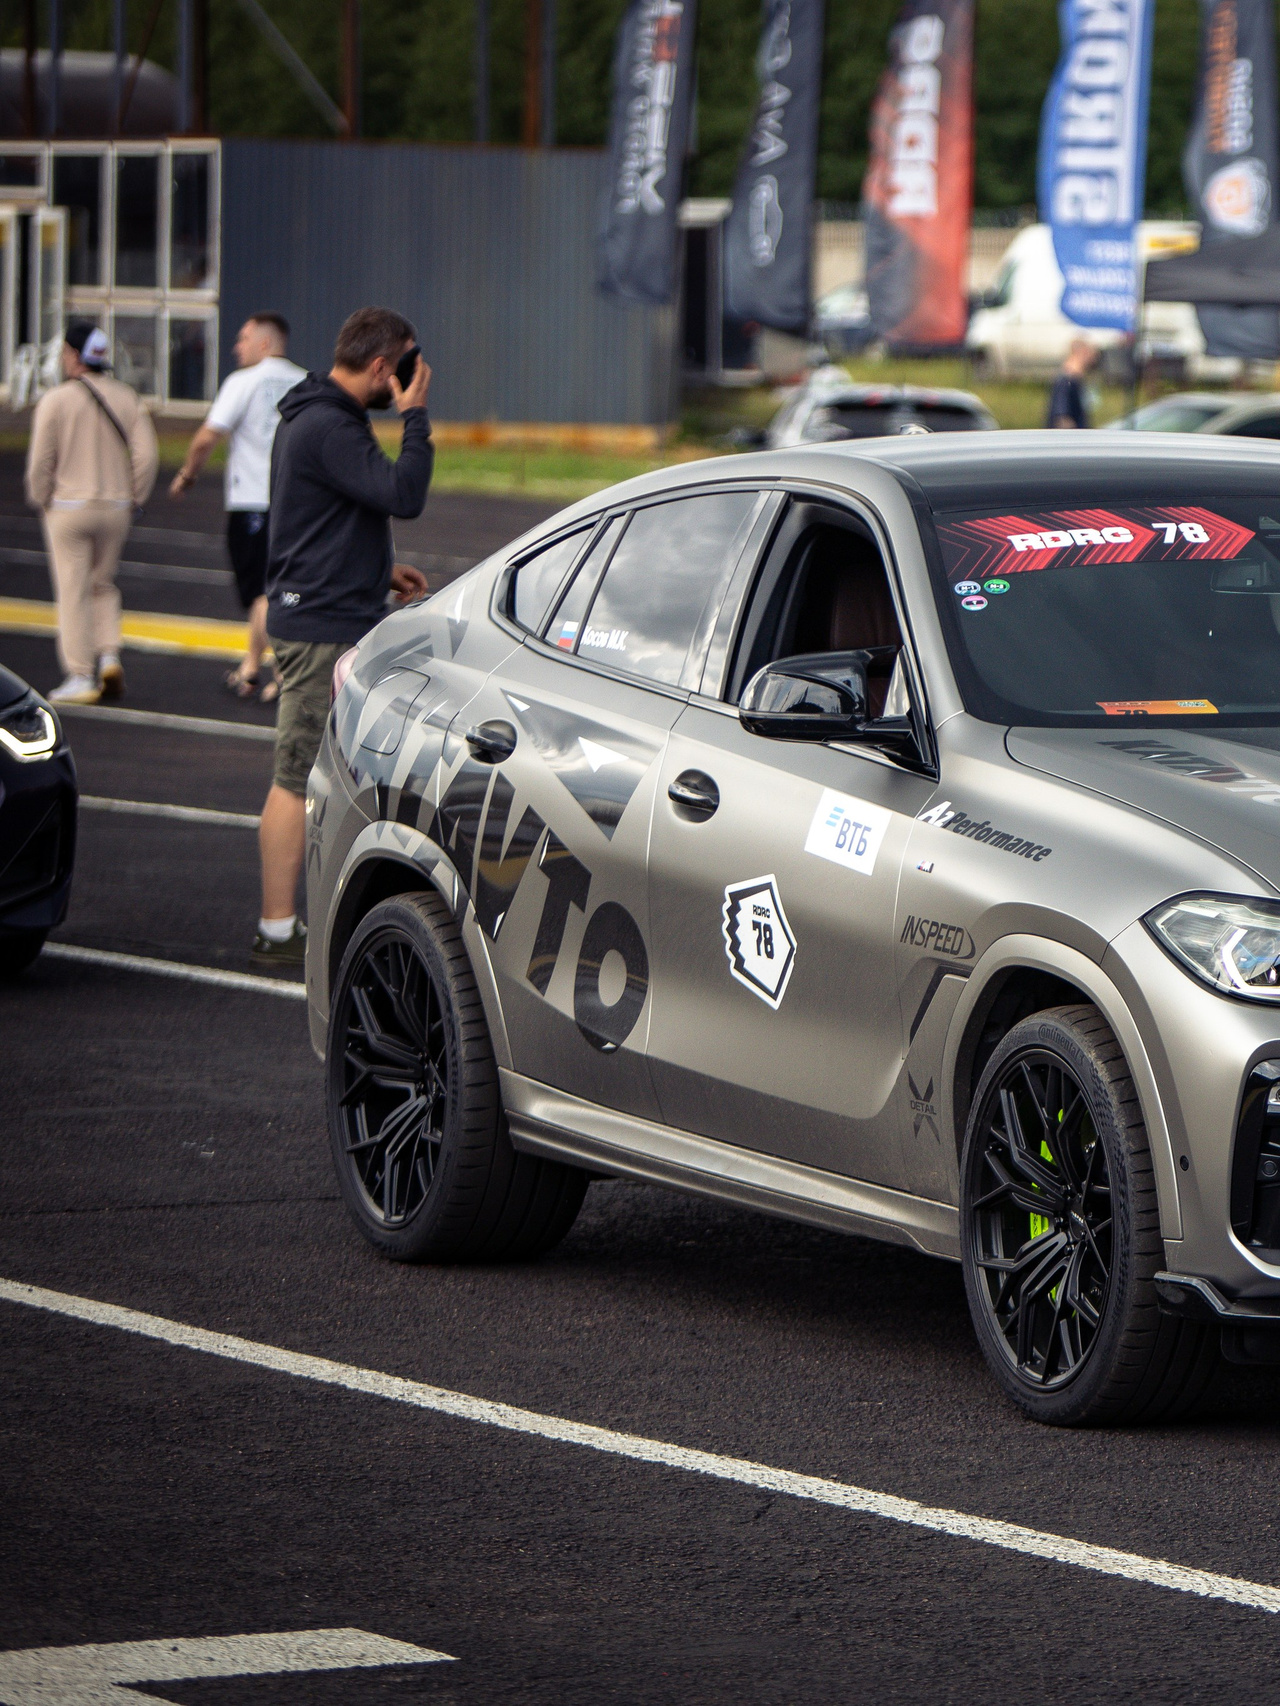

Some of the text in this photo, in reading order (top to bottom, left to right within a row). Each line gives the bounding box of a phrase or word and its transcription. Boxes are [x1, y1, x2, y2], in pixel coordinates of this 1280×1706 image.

[1007, 522, 1211, 552] RDRC 78
[835, 818, 872, 856] ВТБ
[752, 904, 771, 919] RDRC
[752, 920, 775, 960] 78
[900, 914, 965, 956] INSPEED
[1037, 1023, 1081, 1061] Continental
